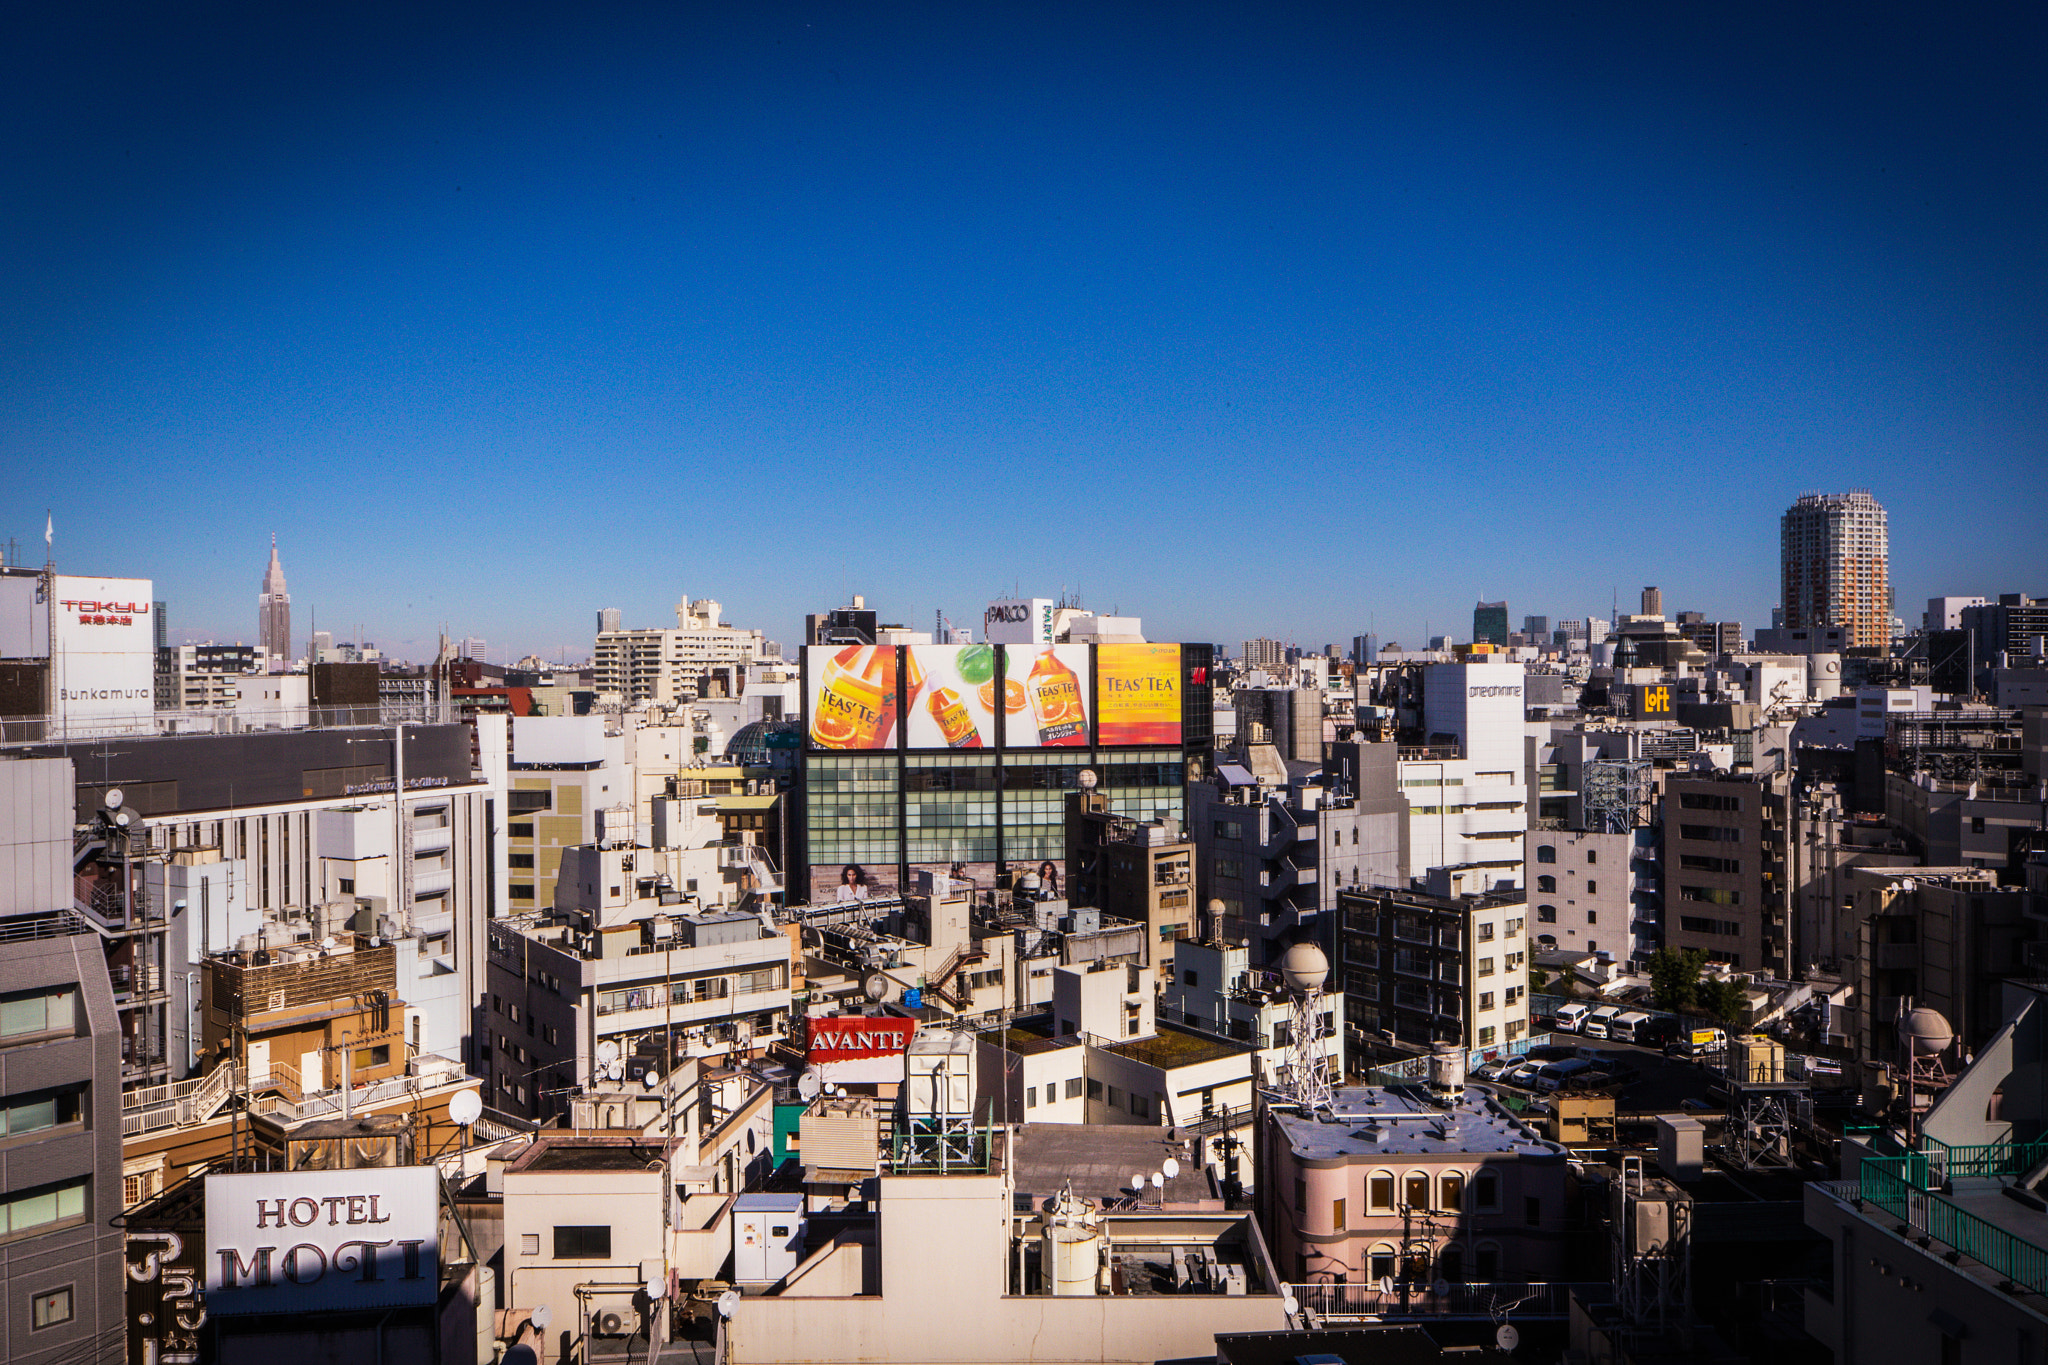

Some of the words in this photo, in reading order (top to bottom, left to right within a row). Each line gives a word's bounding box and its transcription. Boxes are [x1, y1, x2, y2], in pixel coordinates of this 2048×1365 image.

[60, 600, 149, 614] TOKYU
[988, 605, 1030, 623] PARCO
[78, 614, 133, 627] 東急本店
[1106, 677, 1144, 691] TEAS'
[60, 688, 149, 701] Bunkamura
[823, 686, 857, 713] TEAS'
[810, 1031, 905, 1050] AVANTE
[256, 1194, 391, 1228] HOTEL
[216, 1239, 426, 1291] MOTI
